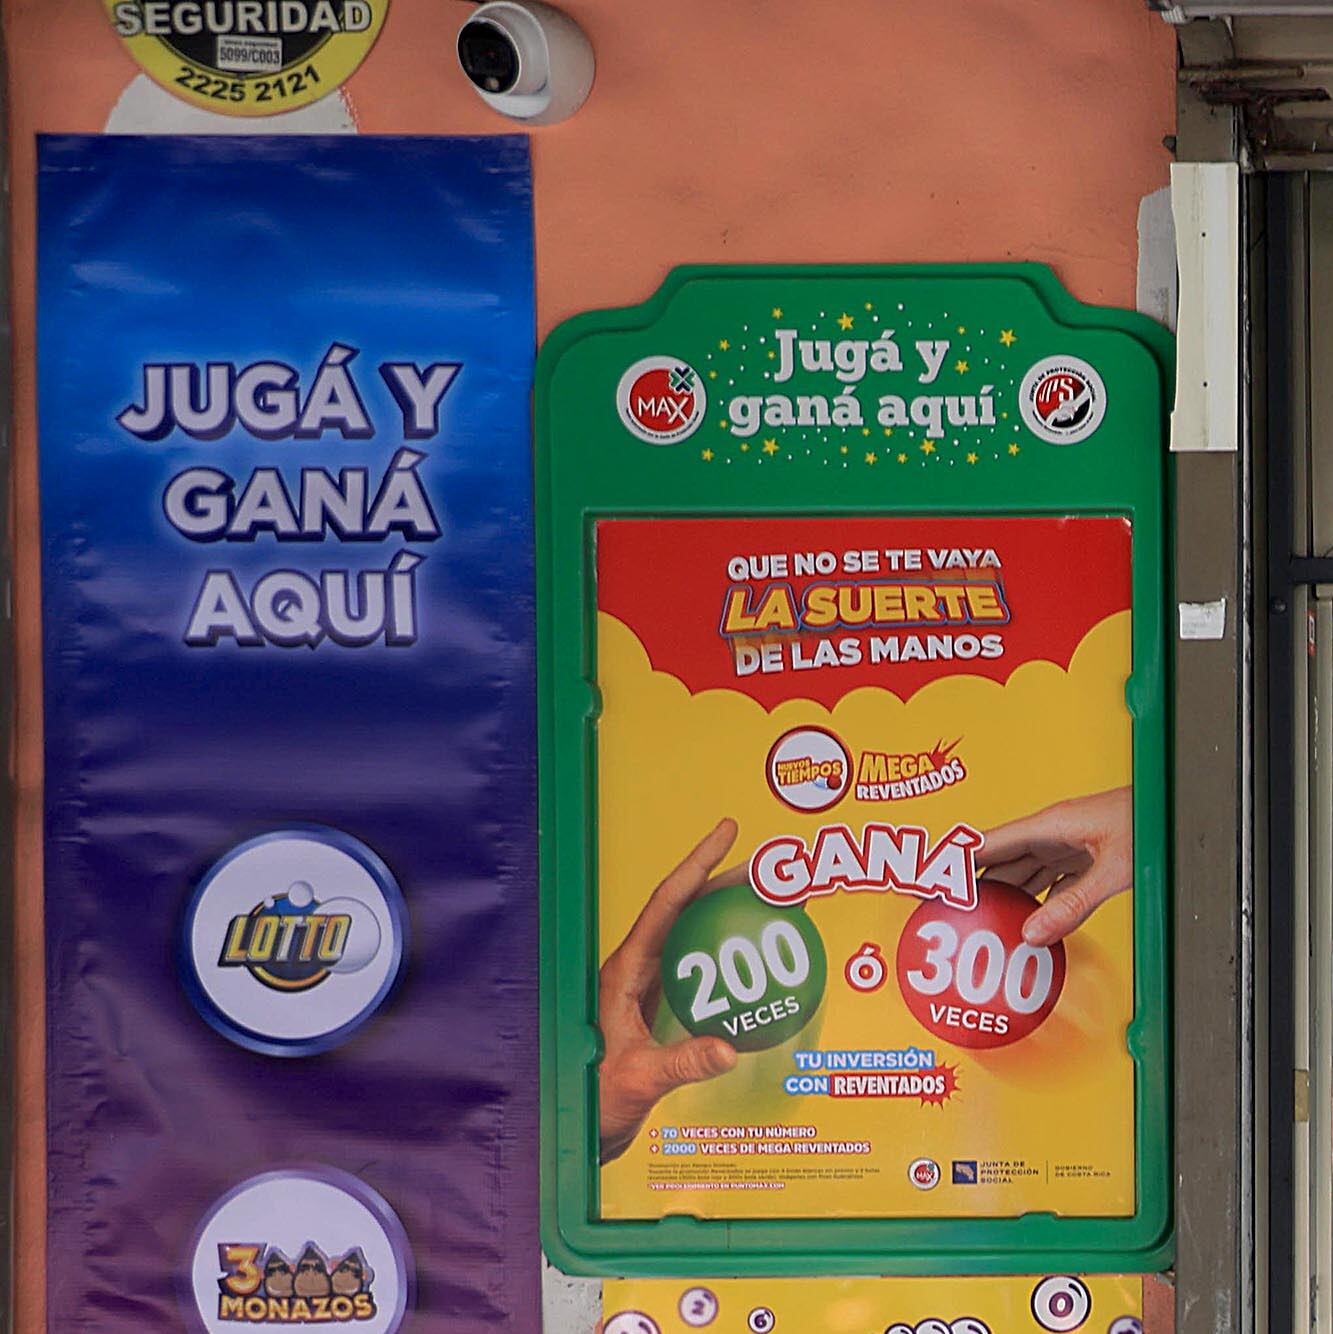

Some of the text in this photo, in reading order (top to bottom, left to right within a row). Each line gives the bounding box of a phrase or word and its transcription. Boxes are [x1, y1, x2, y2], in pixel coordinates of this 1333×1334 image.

[116, 0, 371, 36] SEGURIDAD
[175, 65, 321, 102] 2225 2121
[775, 329, 950, 382] Jugá y
[116, 343, 463, 440] JUGÁ Y
[729, 385, 997, 438] ganá aquí
[164, 448, 442, 543] GANÁ
[727, 548, 1001, 581] QUE NO SE TE VAYA
[185, 551, 426, 649] AQUÍ
[723, 582, 1008, 634] LA SUERTE
[735, 634, 1005, 676] DE LAS MANOS
[776, 760, 844, 786] TIEMPOS
[856, 759, 965, 801] REVENTADOS
[860, 752, 934, 783] MEGA
[750, 824, 984, 910] GANÁ
[218, 914, 351, 967] LOTTO
[676, 920, 811, 1023] 200
[907, 921, 1054, 1015] 300
[723, 996, 801, 1038] VECES
[929, 1003, 1010, 1035] VECES
[795, 1048, 933, 1071] TU INVERSIÓN
[785, 1075, 946, 1096] CON REVENTADOS
[662, 1123, 816, 1139] 70 VECES CON TU NÚMERO
[664, 1142, 871, 1155] 2000 VECES DE MEGA REVENTADOS
[219, 1294, 377, 1323] MONAZOS
